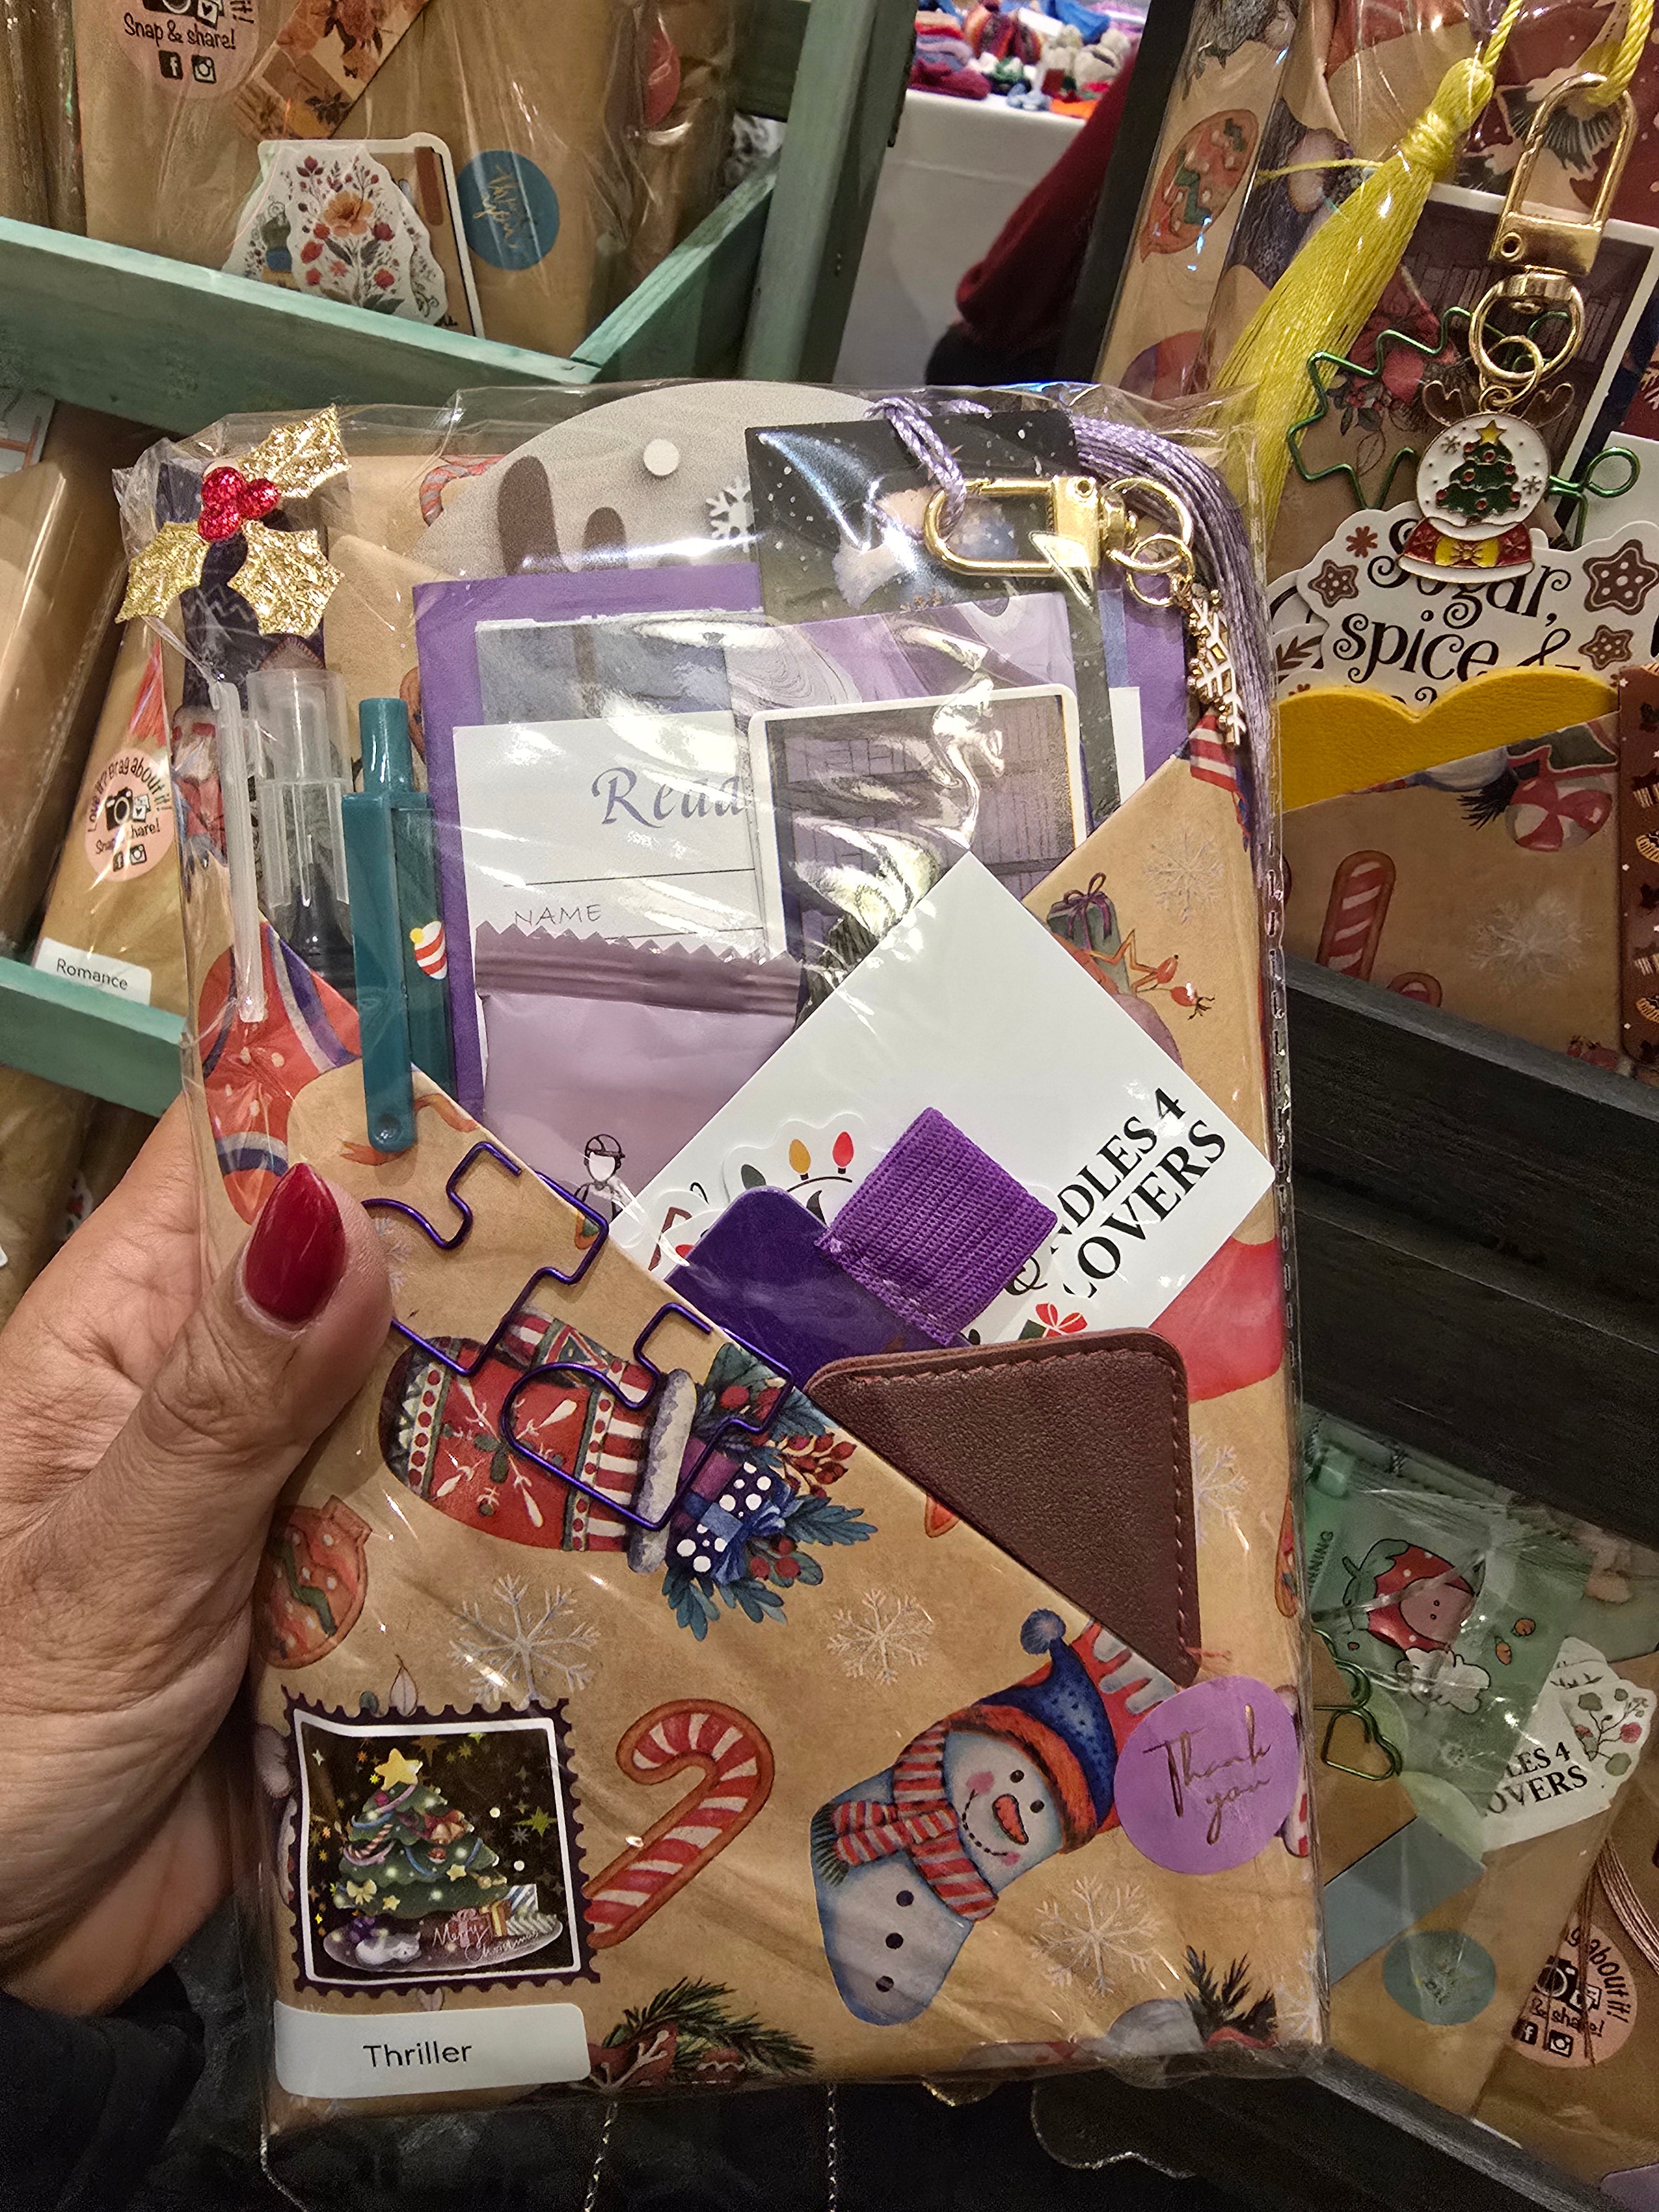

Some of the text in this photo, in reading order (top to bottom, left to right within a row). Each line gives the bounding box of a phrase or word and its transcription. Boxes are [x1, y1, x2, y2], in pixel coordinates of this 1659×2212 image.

[123, 12, 236, 50] Snap & share!
[1333, 610, 1500, 684] spice
[108, 757, 131, 780] Brag
[131, 757, 165, 795] about
[131, 817, 161, 839] hare!
[514, 904, 603, 926] NAME
[56, 957, 128, 990] Romance
[1050, 1088, 1186, 1255] DLES 4
[1555, 1741, 1571, 1762] 4
[1605, 2000, 1631, 2024] it!
[362, 2041, 473, 2068] Thriller
